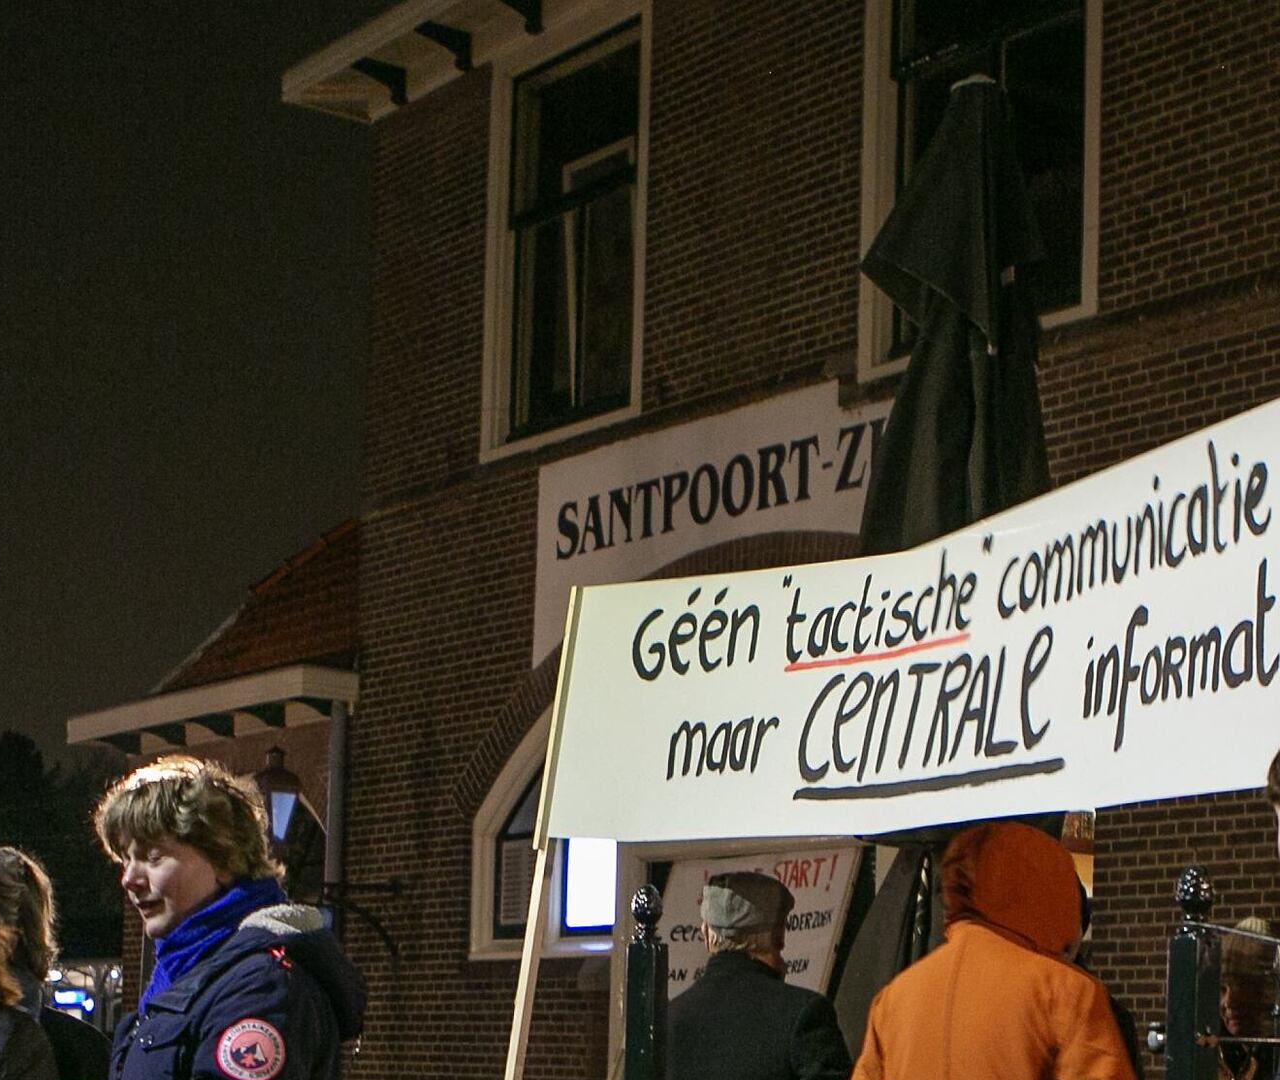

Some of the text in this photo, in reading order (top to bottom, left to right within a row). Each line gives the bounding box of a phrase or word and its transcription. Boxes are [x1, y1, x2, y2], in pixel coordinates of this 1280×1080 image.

[632, 587, 760, 682] Géén
[997, 440, 1272, 619] communicatie
[666, 716, 780, 781] maar
[668, 968, 688, 982] AN
